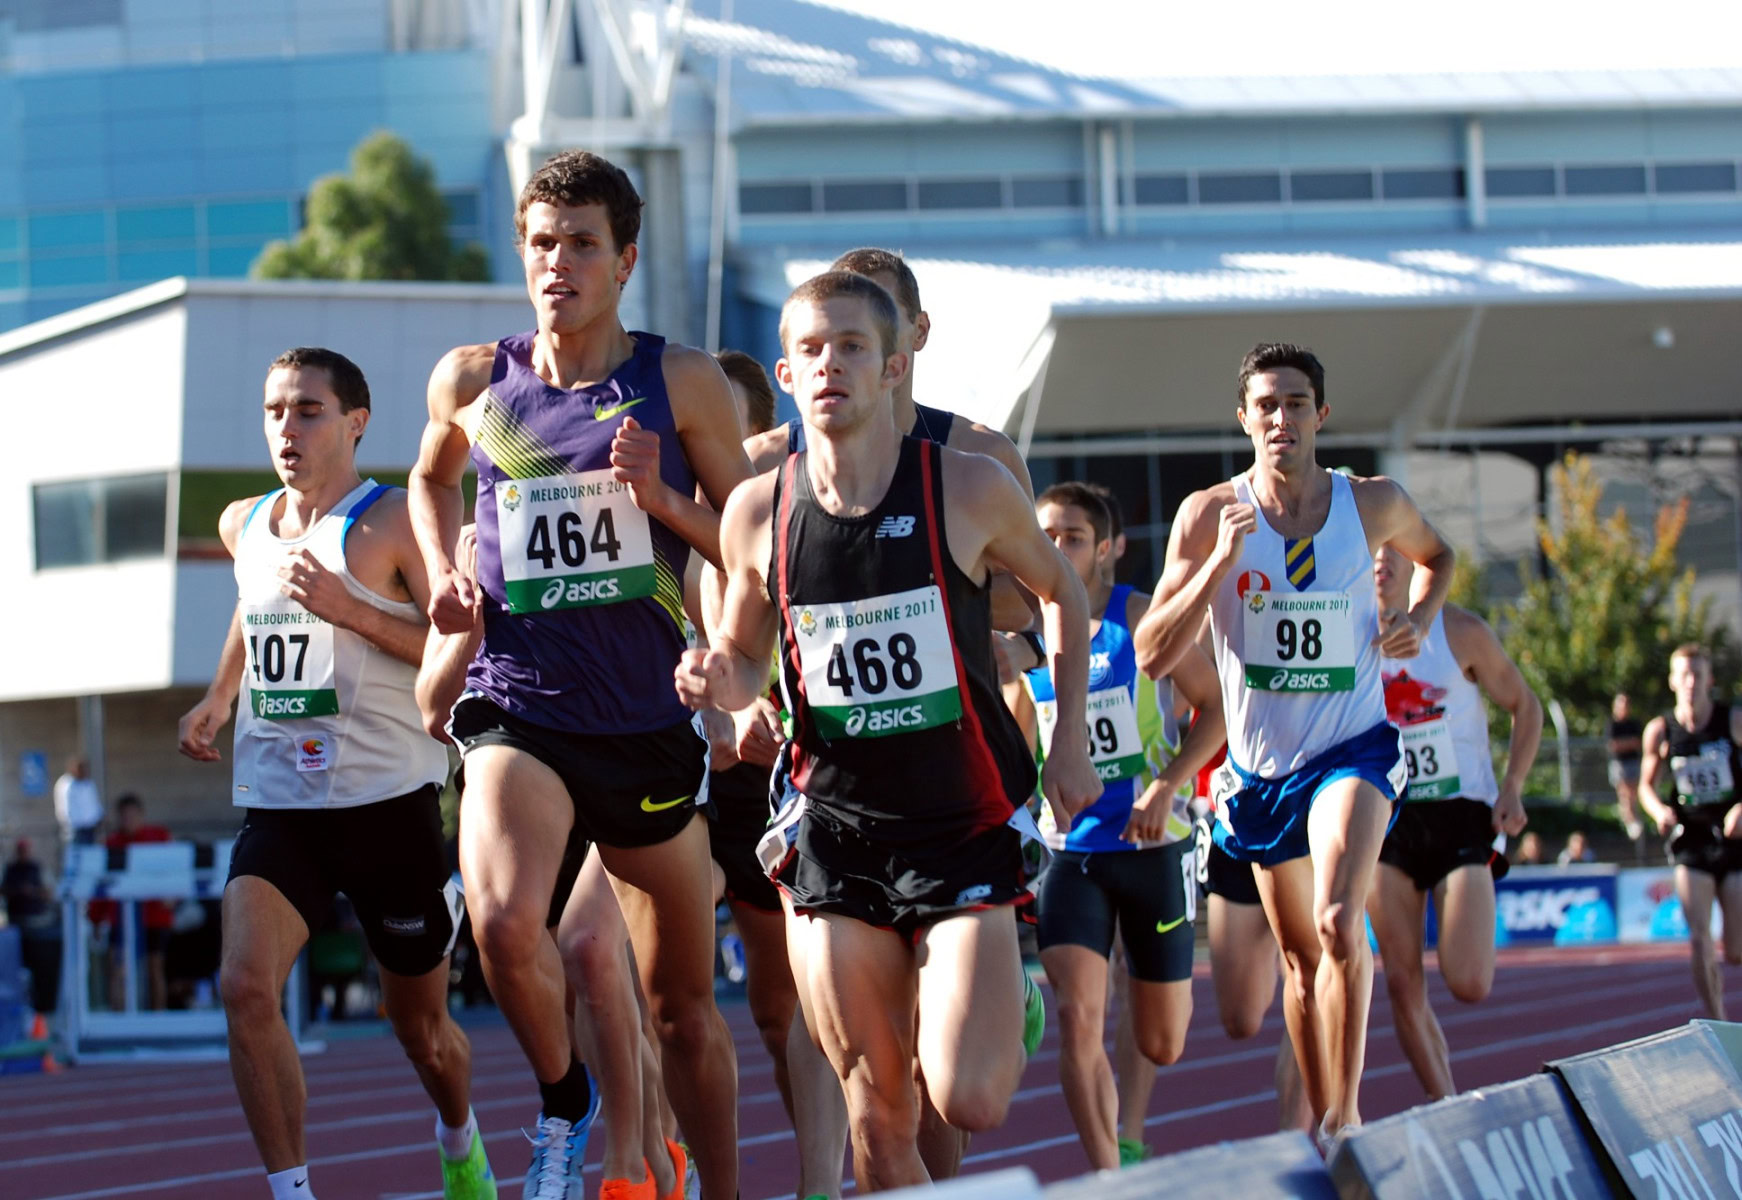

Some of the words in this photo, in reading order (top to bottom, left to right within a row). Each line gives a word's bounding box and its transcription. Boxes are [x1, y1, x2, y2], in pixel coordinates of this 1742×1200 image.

[530, 482, 602, 503] MELBOURNE
[606, 481, 632, 494] 201
[527, 507, 621, 569] 464
[826, 607, 900, 630] MELBOURNE
[905, 599, 935, 619] 2011
[1271, 600, 1326, 611] MELBOURNE
[1329, 599, 1349, 611] 2011
[246, 613, 302, 626] MELBOURNE
[1276, 619, 1322, 661] 98
[827, 633, 922, 697] 468
[1105, 695, 1125, 709] 2011
